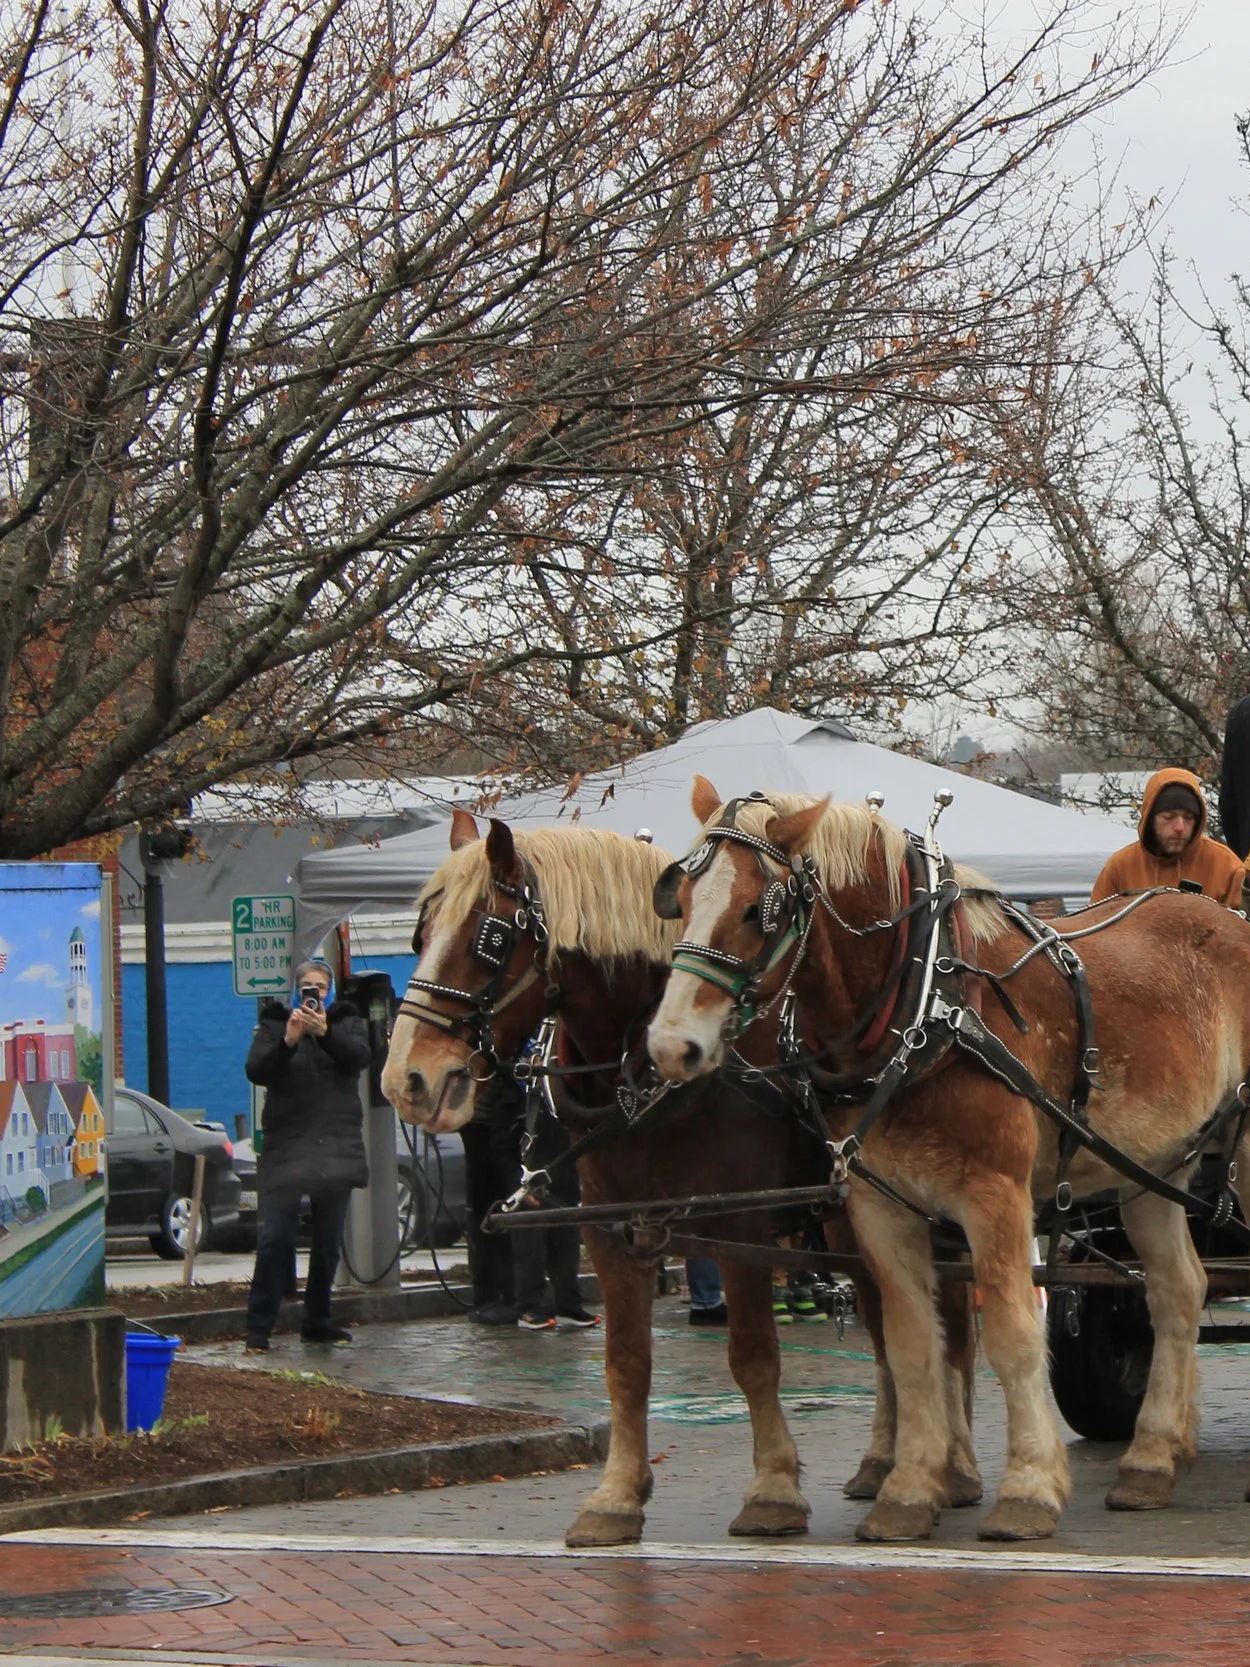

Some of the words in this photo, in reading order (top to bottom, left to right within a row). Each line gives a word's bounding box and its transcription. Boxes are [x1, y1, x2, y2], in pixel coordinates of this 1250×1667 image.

[236, 904, 250, 928] 2
[264, 901, 280, 913] HR
[254, 916, 293, 928] PARKING
[244, 938, 267, 951] 8:00
[272, 937, 286, 949] AM
[240, 957, 250, 969] TO
[255, 956, 275, 969] 5:00
[279, 956, 292, 968] PM
